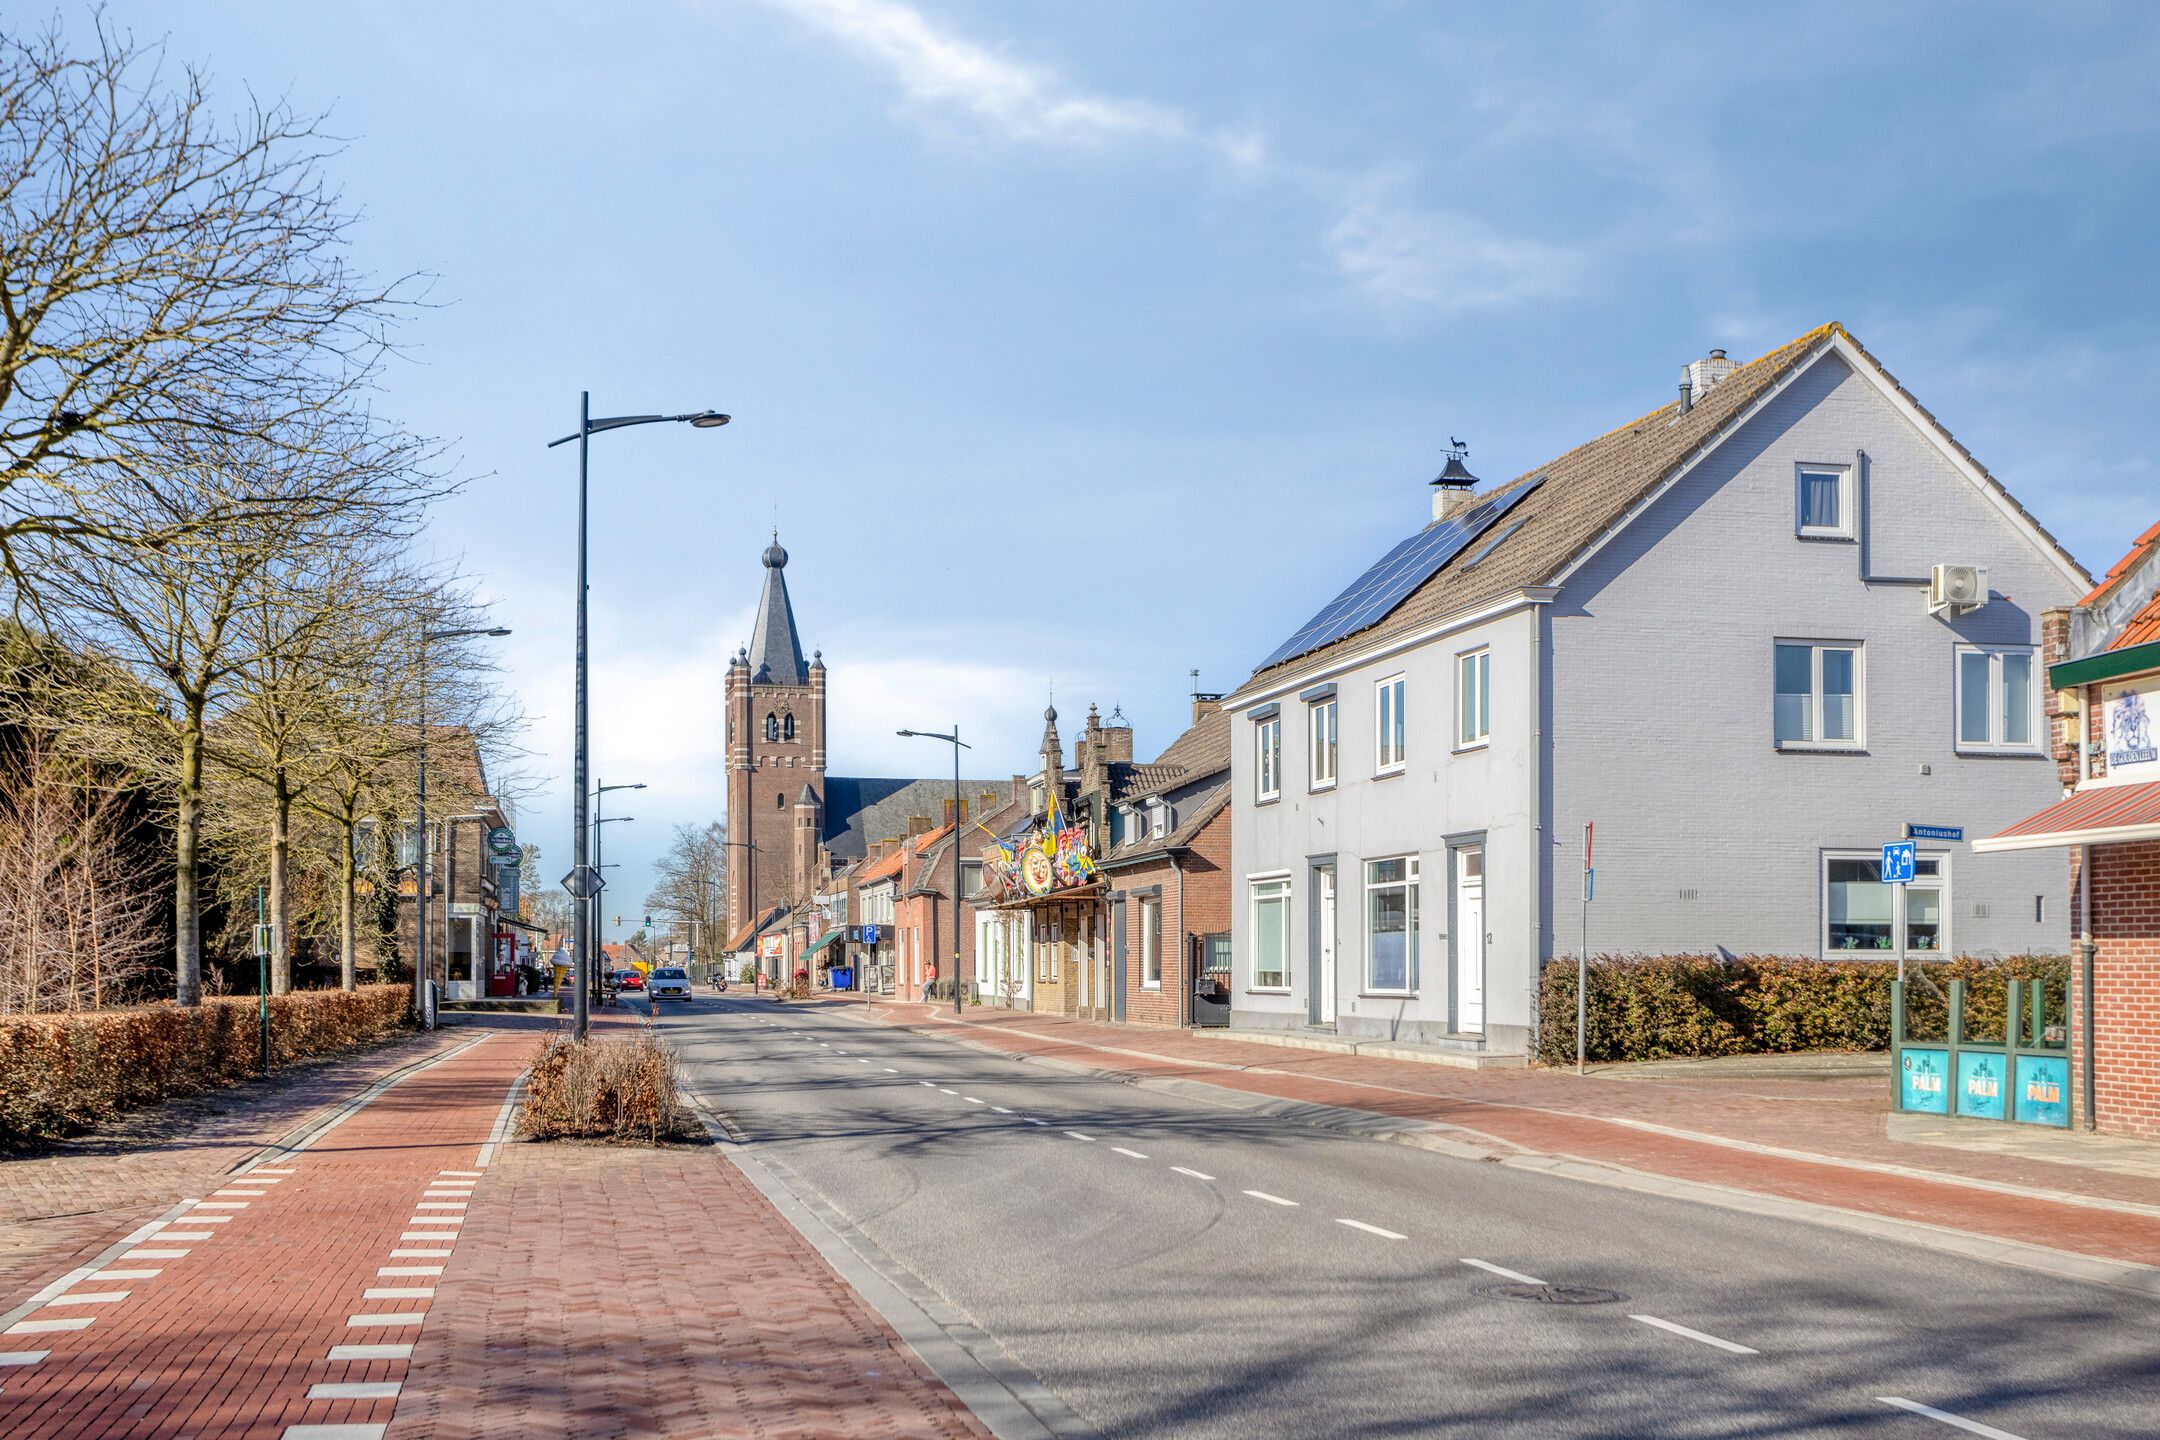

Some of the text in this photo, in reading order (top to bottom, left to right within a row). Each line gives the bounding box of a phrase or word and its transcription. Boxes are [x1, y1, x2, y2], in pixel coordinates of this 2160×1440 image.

[1913, 827, 1960, 838] Antoniushof
[865, 926, 873, 936] P
[1912, 1075, 1941, 1092] PALM
[1968, 1079, 1998, 1097] PALM
[2027, 1084, 2060, 1103] PALM
